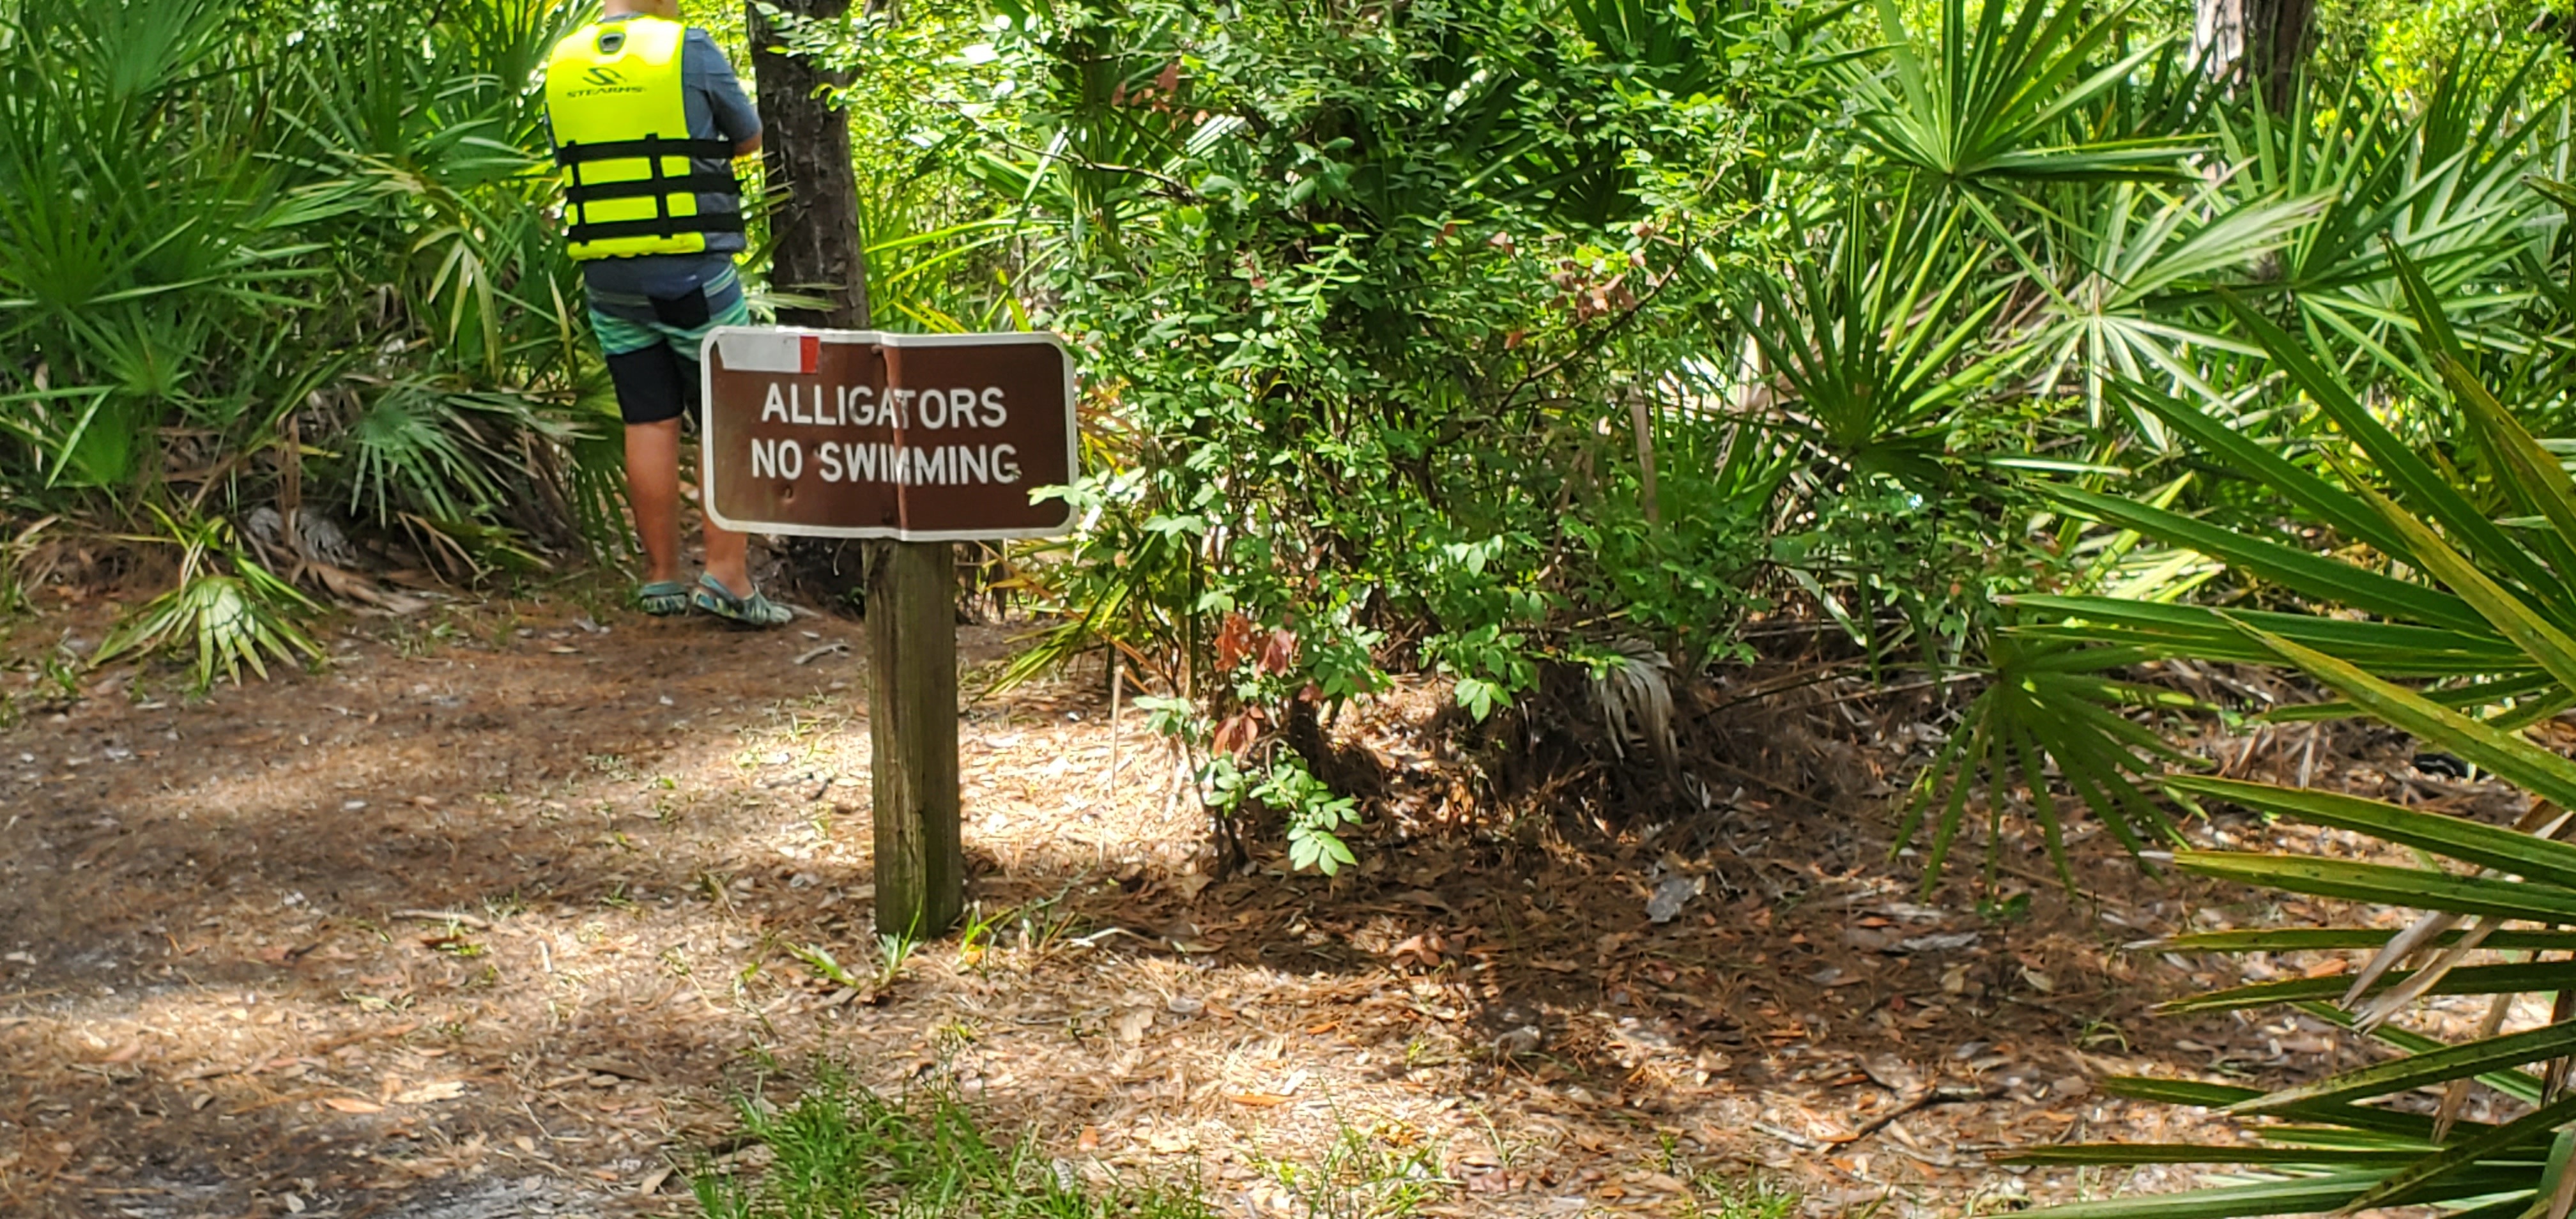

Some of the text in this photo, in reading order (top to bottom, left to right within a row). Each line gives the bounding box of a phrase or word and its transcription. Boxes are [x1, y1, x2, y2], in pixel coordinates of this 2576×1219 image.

[762, 383, 1007, 429] ALLIGATORS
[751, 438, 1019, 486] NO SWIMMING
